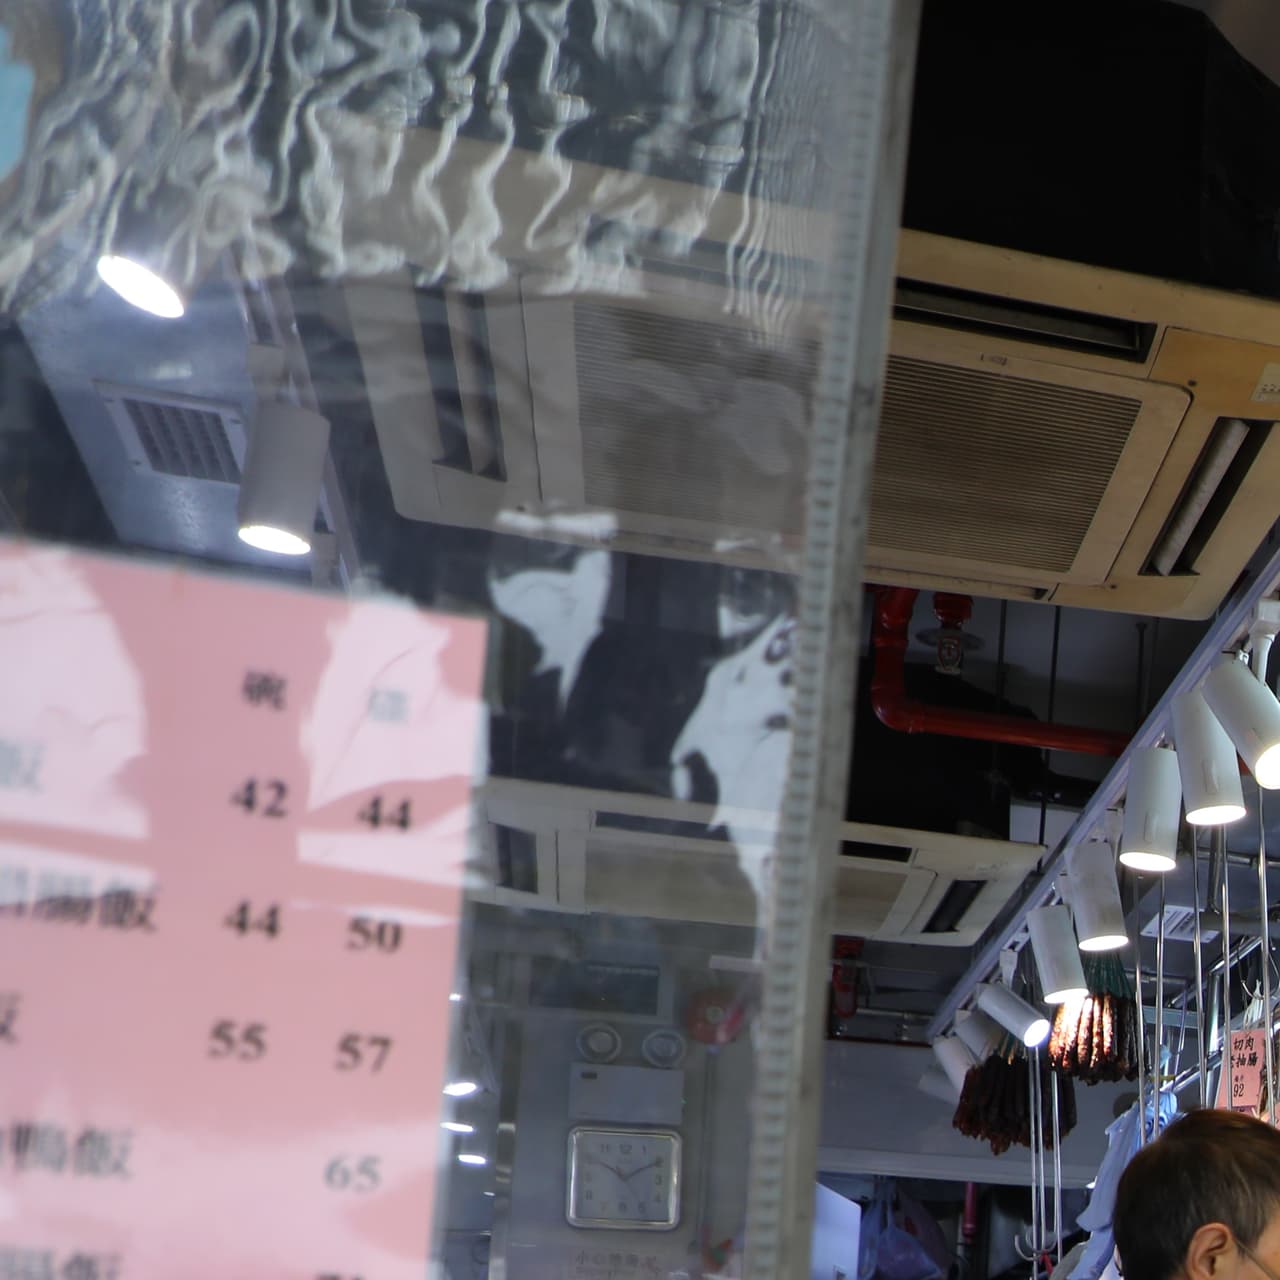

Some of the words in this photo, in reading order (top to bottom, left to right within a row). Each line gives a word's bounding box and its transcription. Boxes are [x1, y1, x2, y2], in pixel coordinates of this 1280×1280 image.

[229, 777, 288, 818] 42
[357, 796, 413, 831] 44
[222, 900, 280, 939] 44
[345, 914, 403, 953] 50
[207, 1020, 267, 1062] 55
[334, 1032, 394, 1075] 57
[1233, 1083, 1245, 1097] 92
[324, 1155, 382, 1193] 65
